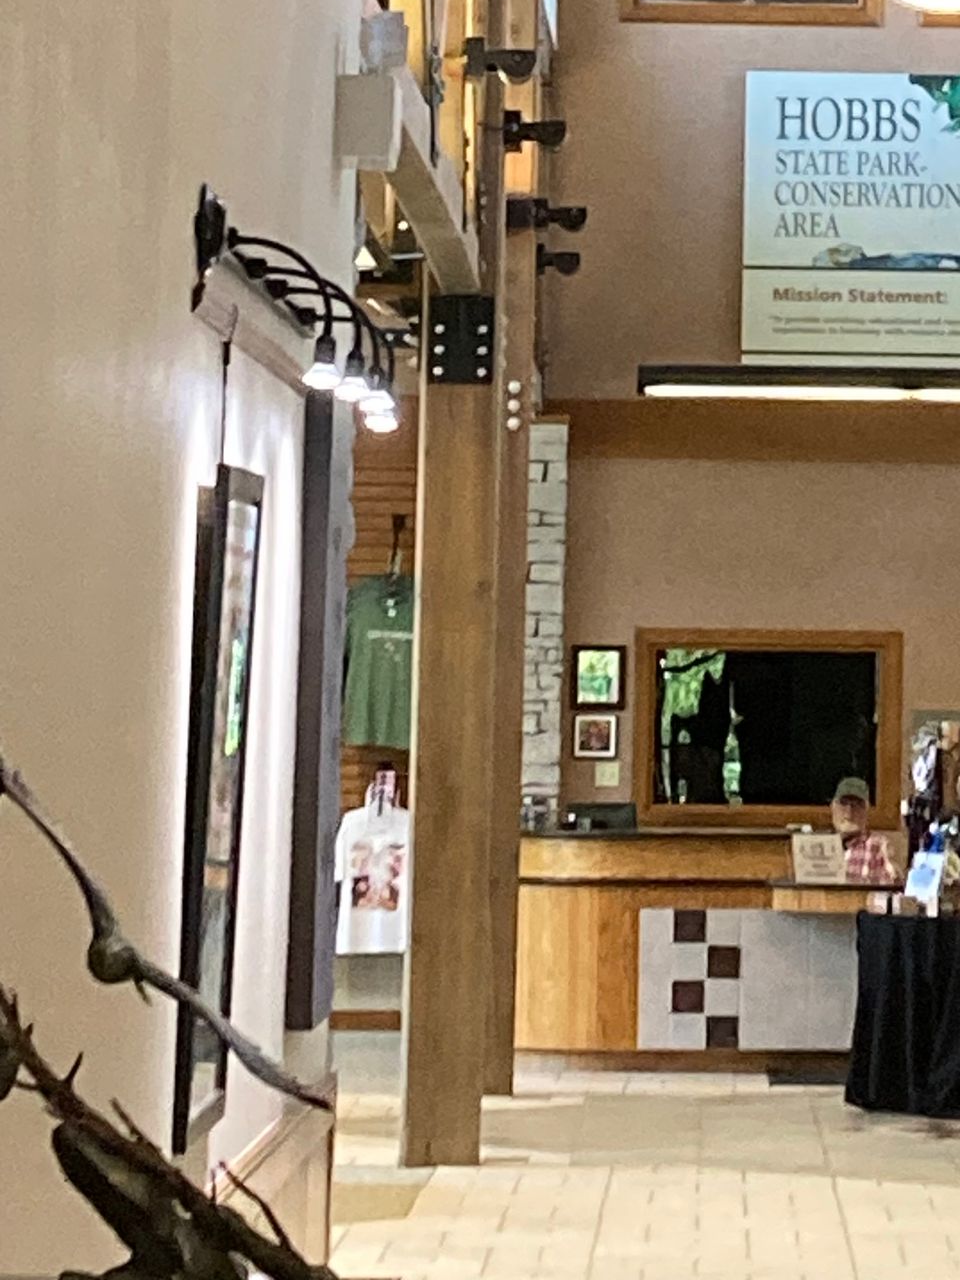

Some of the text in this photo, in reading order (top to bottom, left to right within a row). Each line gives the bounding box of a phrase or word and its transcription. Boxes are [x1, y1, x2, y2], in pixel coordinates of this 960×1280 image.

[776, 96, 921, 142] HOBBS
[775, 149, 849, 175] STATE
[774, 212, 840, 238] AREA
[772, 287, 843, 303] Mission
